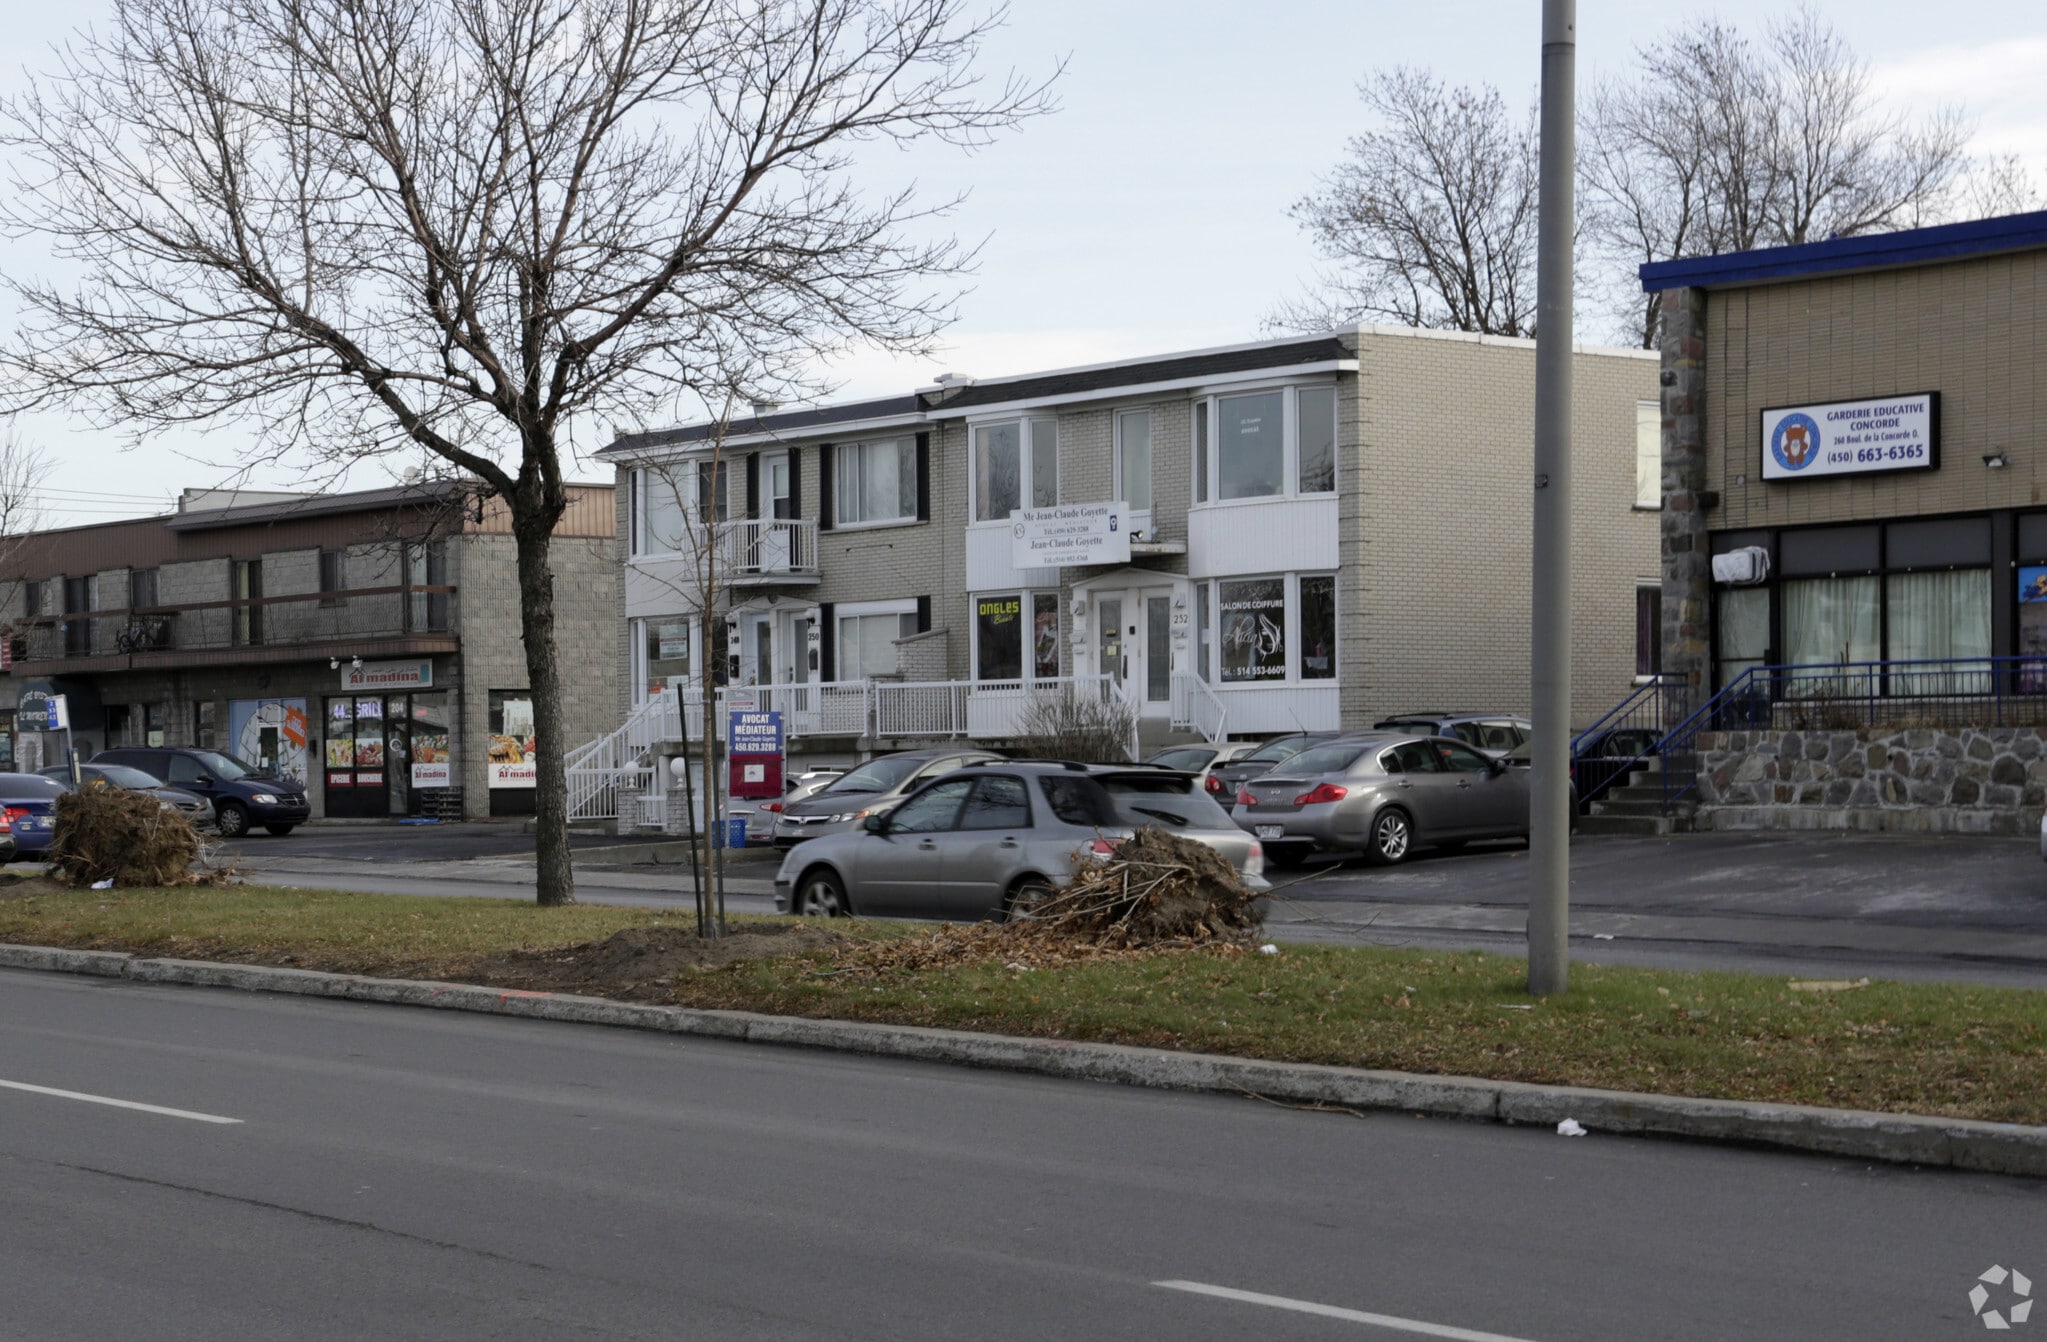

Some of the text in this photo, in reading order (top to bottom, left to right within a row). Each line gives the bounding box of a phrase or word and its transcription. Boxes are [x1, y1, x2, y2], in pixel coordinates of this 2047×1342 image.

[1827, 403, 1924, 422] GARDERIE EDUCATIVE
[1850, 418, 1900, 431] CONCORDE
[1834, 436, 1845, 446] 260
[1846, 434, 1862, 445] Boul.
[1864, 432, 1872, 443] de
[1873, 432, 1880, 442] la
[1881, 431, 1911, 442] Concorde
[1827, 444, 1924, 466] (450) 663-6365
[1036, 509, 1079, 521] Jean-Claude
[1080, 507, 1108, 519] Goyette
[1031, 536, 1103, 550] Jean-Claude Goyette
[980, 601, 1019, 615] ONGLES
[1220, 600, 1283, 610] SALON DE COIFFURE
[1174, 614, 1188, 624] 252
[808, 632, 819, 641] 250
[1237, 666, 1251, 676] 514
[1252, 665, 1285, 675] 553-6609
[367, 672, 418, 683] madina
[356, 701, 383, 718] GRILL
[391, 702, 404, 713] 204
[741, 714, 769, 724] AVOCAT
[735, 723, 776, 735] MÉDIATEUR
